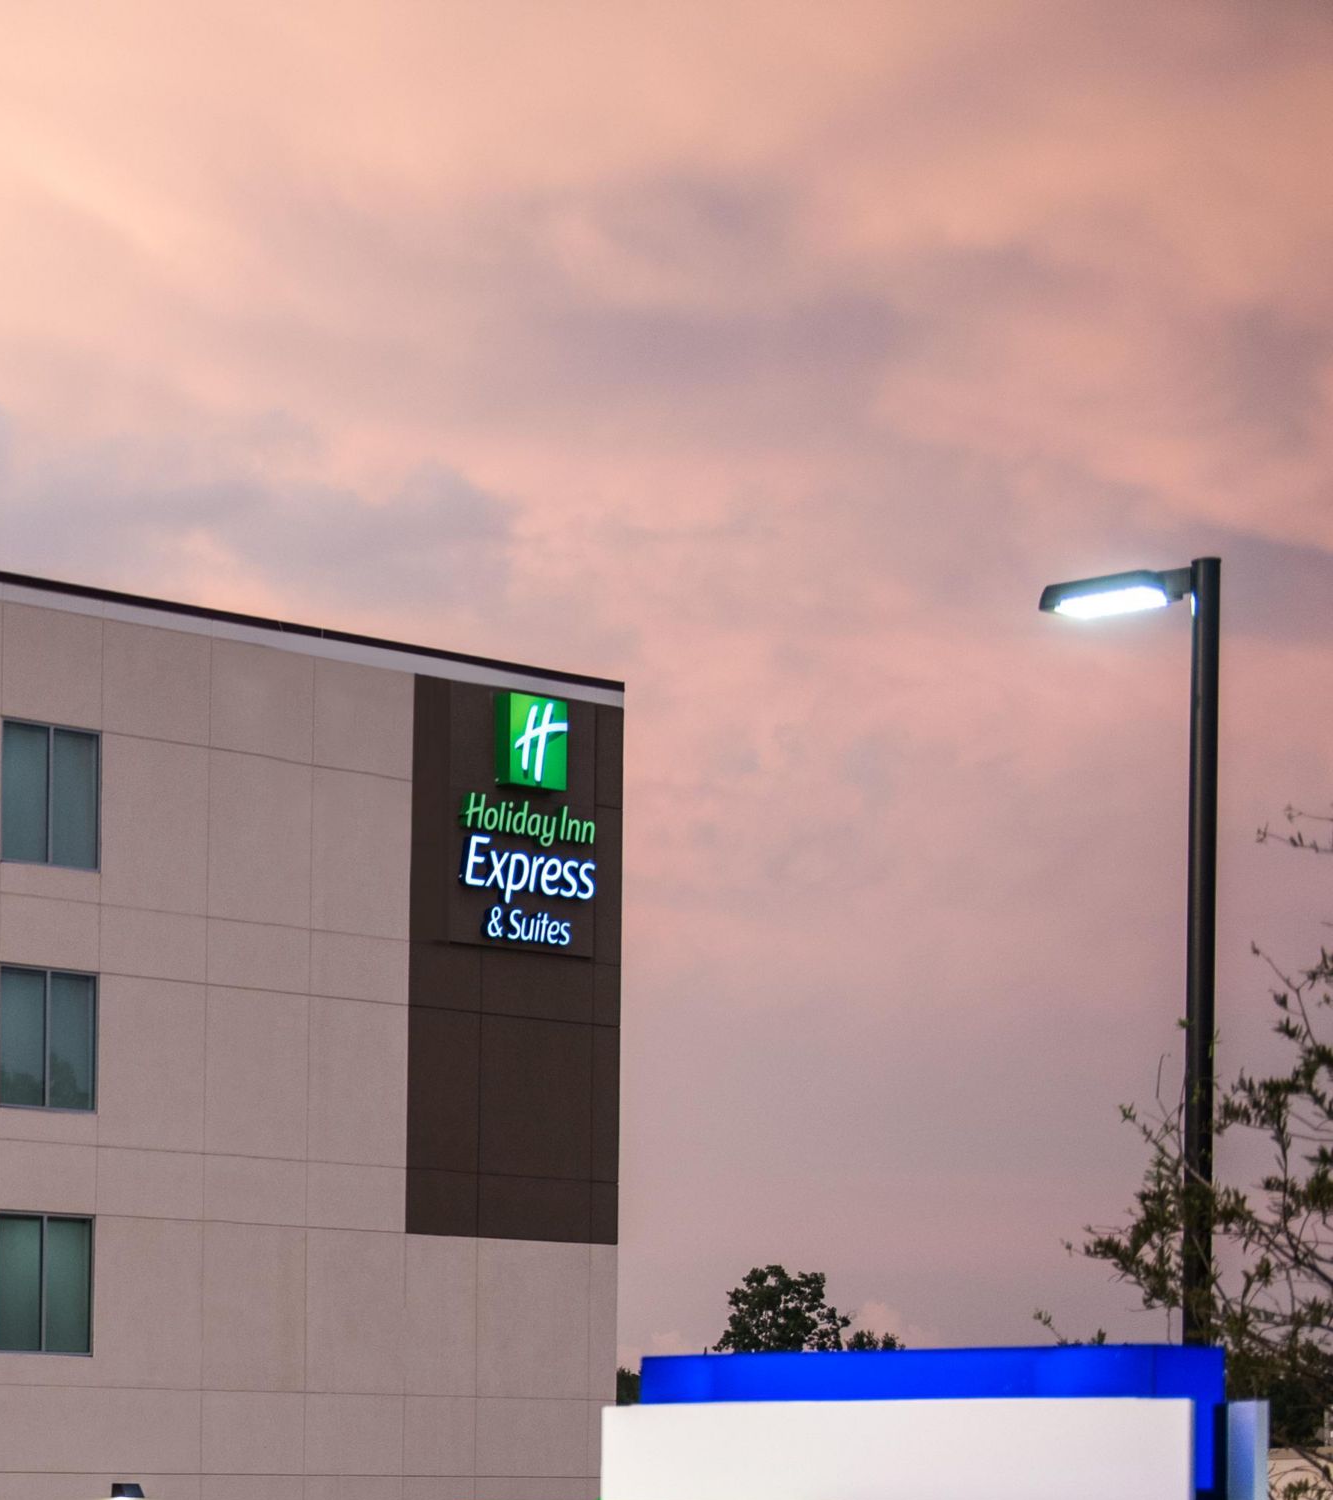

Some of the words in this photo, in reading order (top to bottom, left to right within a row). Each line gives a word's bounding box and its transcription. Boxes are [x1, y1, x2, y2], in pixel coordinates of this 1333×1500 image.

[465, 792, 557, 847] Holiday
[560, 806, 596, 844] Inn
[464, 835, 596, 903] Express
[487, 906, 504, 938] &
[507, 909, 571, 946] Suites
